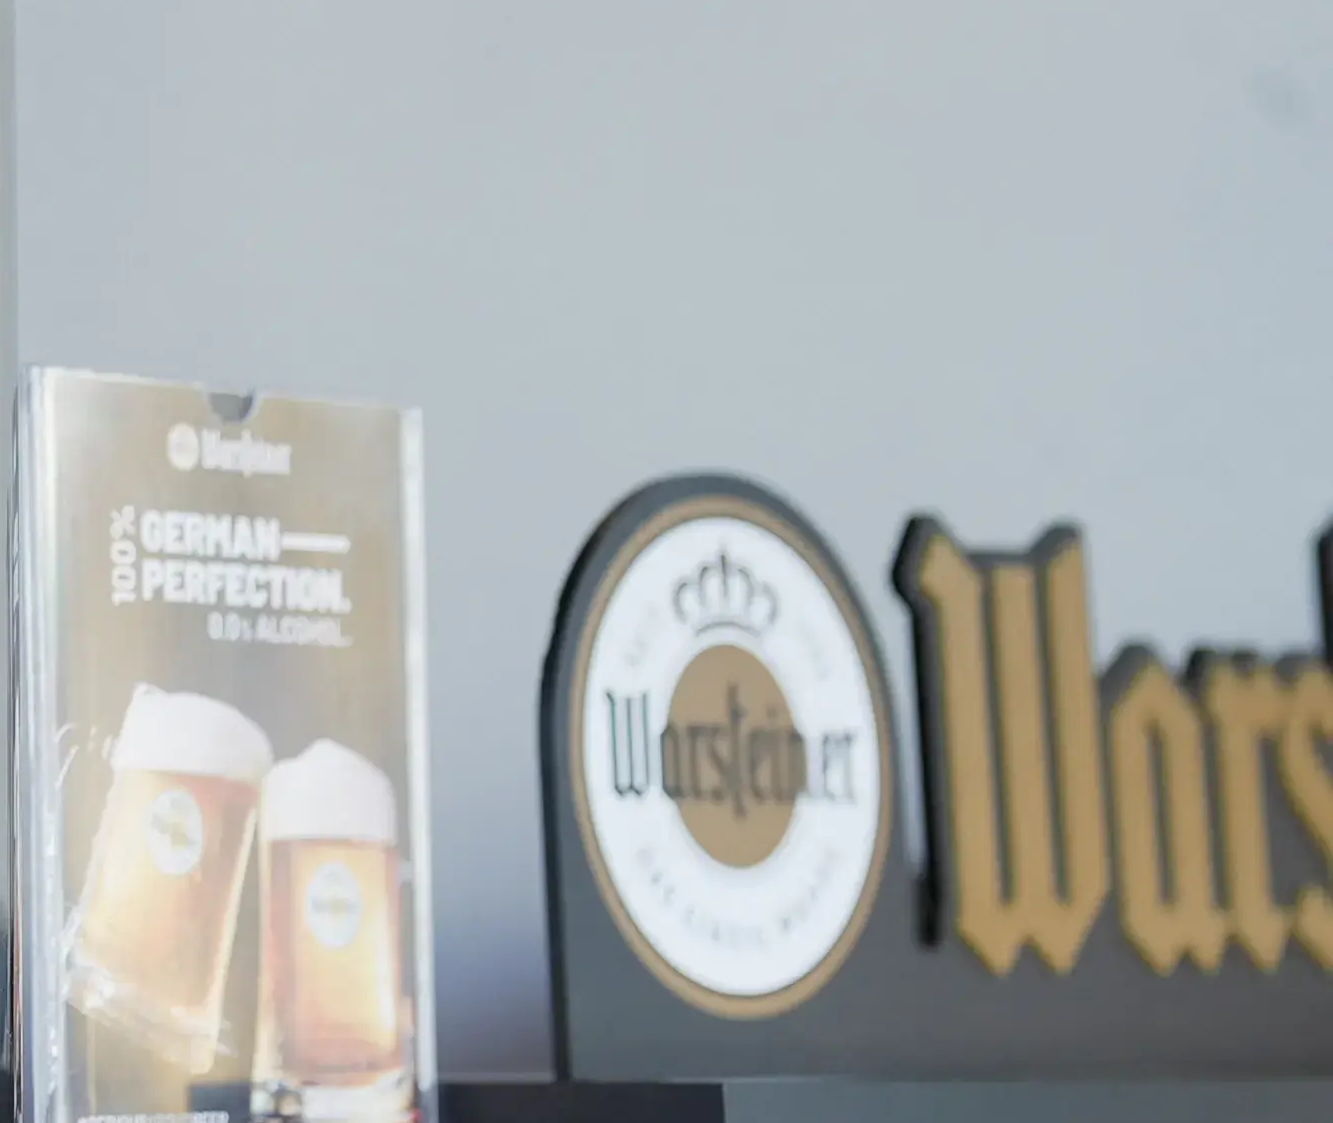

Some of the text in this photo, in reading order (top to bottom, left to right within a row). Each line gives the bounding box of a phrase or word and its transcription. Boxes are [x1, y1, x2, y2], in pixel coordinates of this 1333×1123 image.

[109, 504, 137, 607] 100%
[140, 508, 282, 562] GERMAN
[140, 556, 353, 615] PERFECTION.
[605, 681, 859, 820] Warsteiner
